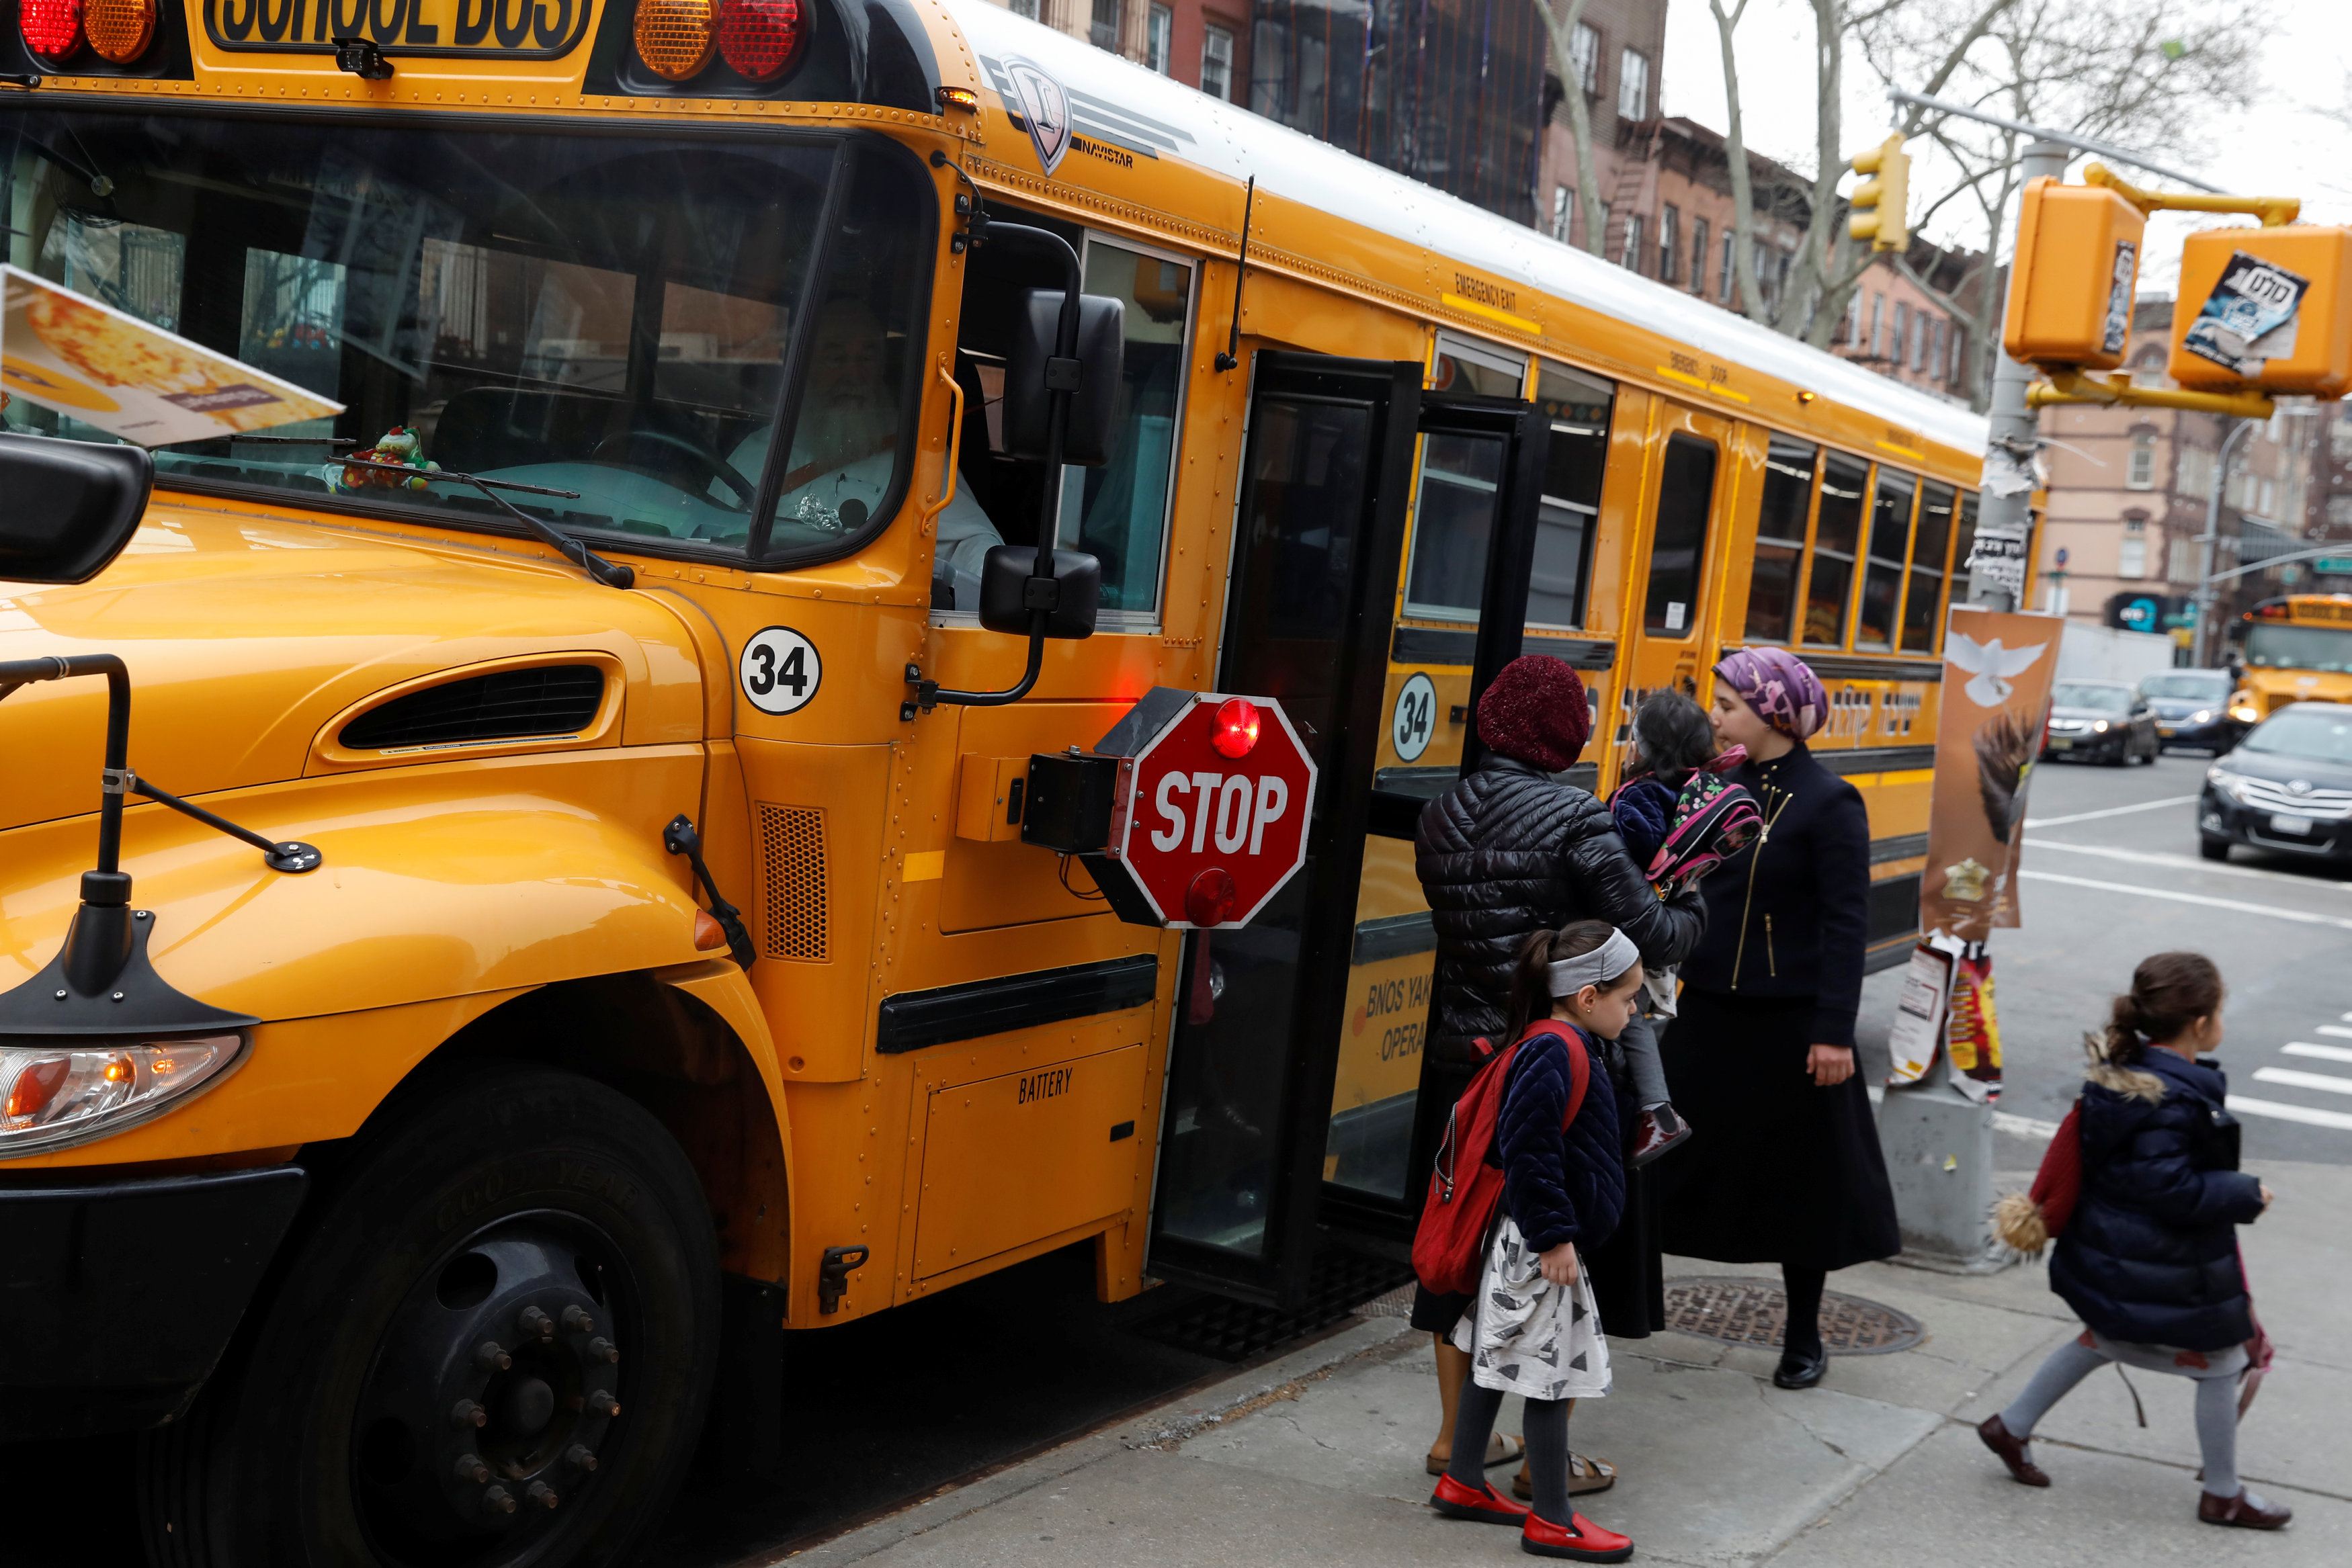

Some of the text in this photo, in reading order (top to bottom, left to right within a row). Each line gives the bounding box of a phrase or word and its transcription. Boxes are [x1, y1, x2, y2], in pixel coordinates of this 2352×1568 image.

[1082, 139, 1134, 169] NAVISTAR
[1455, 272, 1516, 312] EMERGENCY EXIT
[749, 644, 808, 697] 34
[1400, 691, 1427, 744] 34
[1150, 771, 1288, 855] STOP
[1366, 979, 1405, 1018] BNOS
[1017, 1067, 1073, 1105] BATTERY
